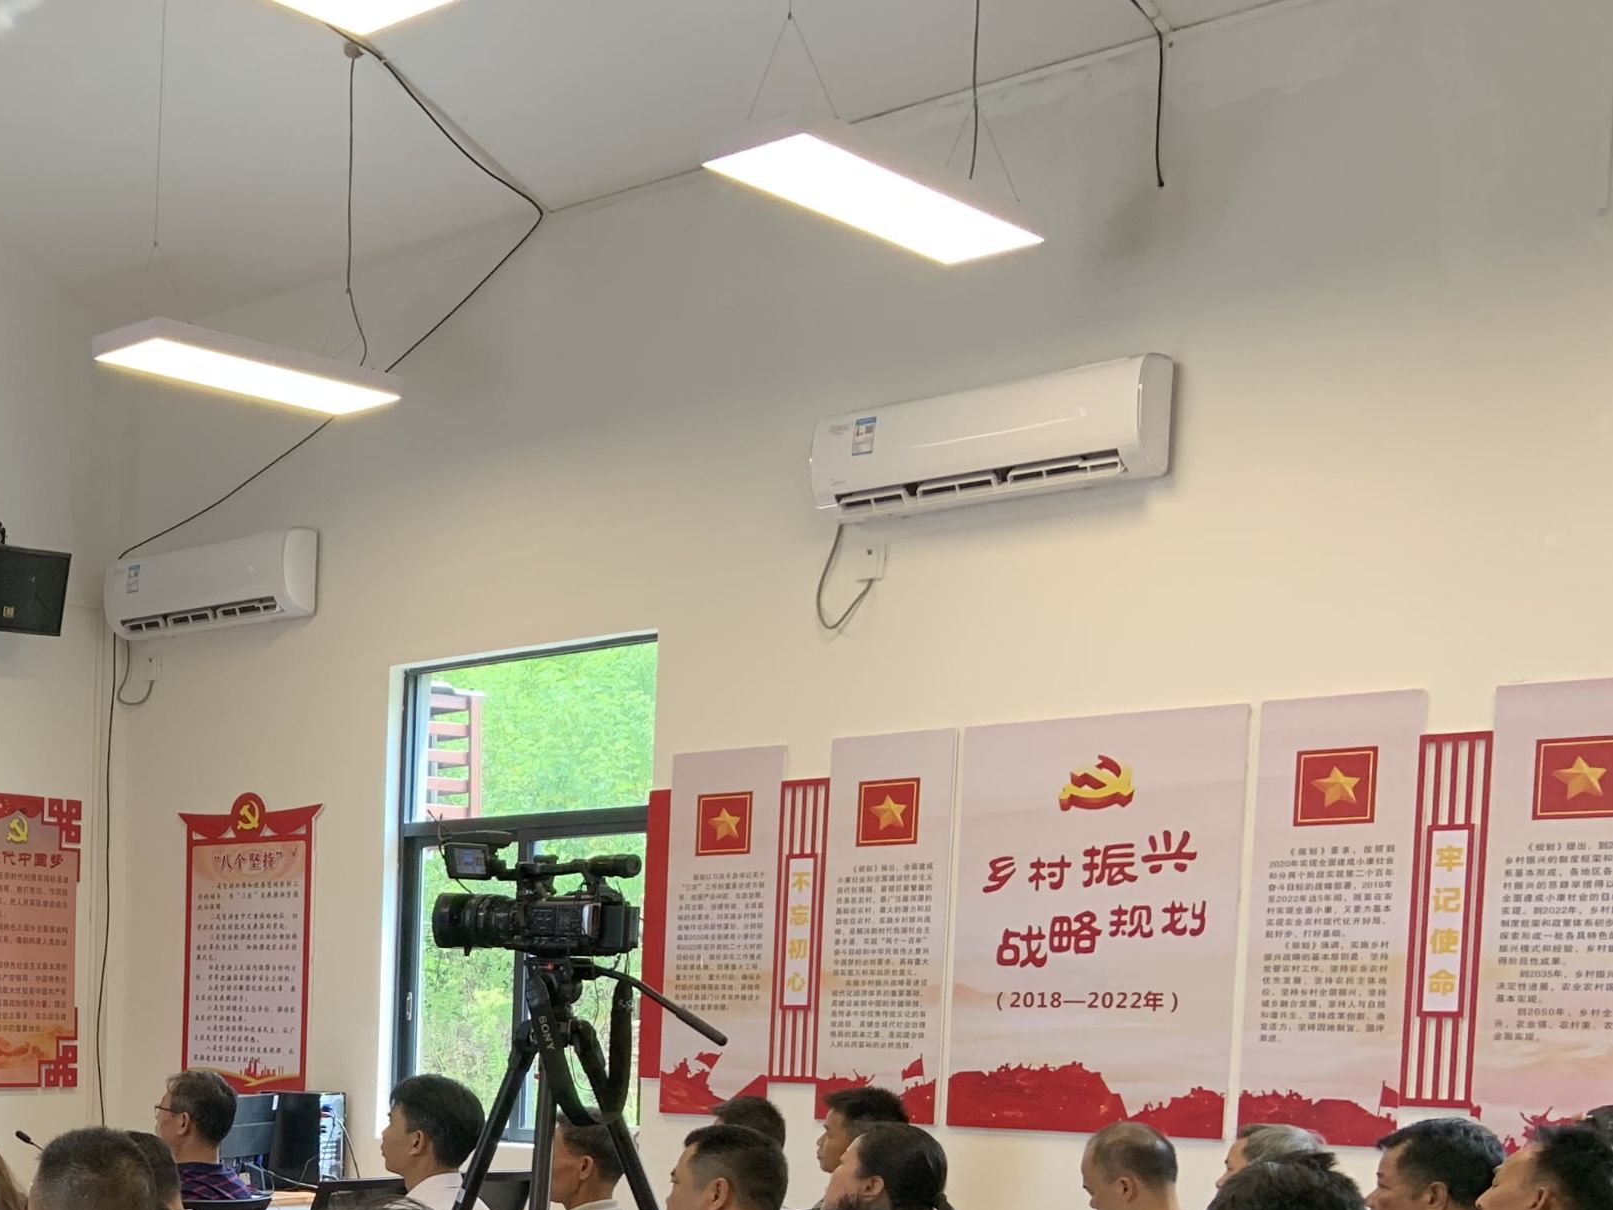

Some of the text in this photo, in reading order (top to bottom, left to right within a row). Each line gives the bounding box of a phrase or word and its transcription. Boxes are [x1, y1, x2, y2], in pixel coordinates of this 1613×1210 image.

[213, 851, 284, 872] “八个坚持”
[982, 829, 1198, 893] 乡村振兴
[787, 871, 811, 992] 不忘初心
[995, 900, 1207, 968] 战略规划
[1428, 845, 1464, 995] 牢记使命
[538, 1015, 555, 1050] SONY
